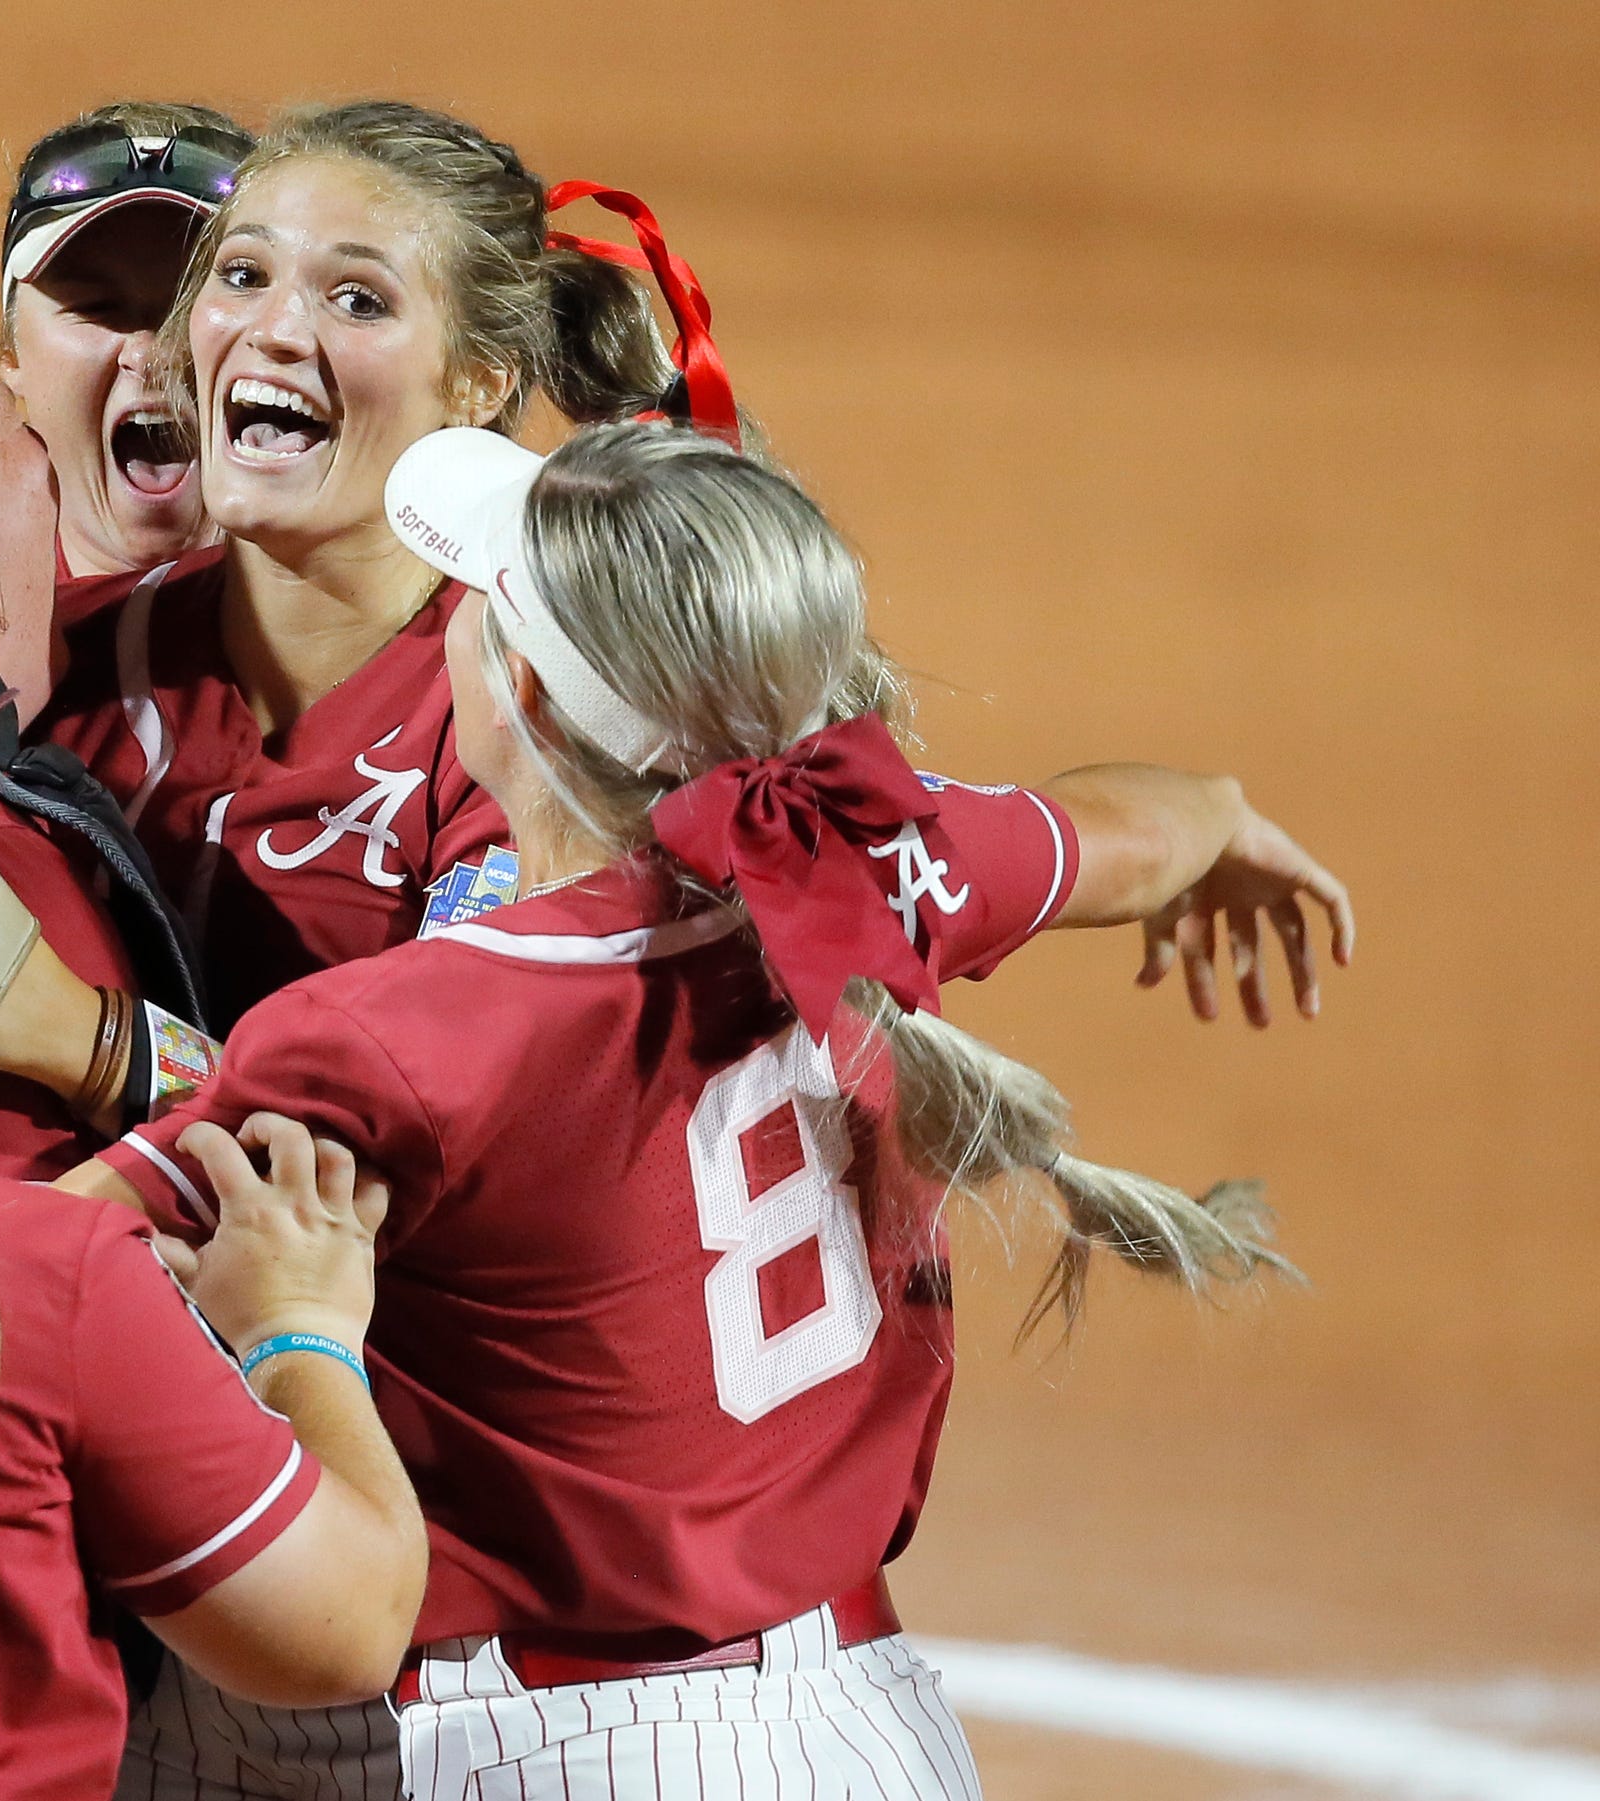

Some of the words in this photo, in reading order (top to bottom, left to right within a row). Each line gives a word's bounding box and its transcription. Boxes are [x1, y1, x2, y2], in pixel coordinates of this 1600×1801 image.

[396, 505, 463, 563] SOFTBALL
[257, 753, 427, 888] A
[458, 897, 480, 909] 2021
[487, 868, 515, 883] NCAA
[867, 818, 970, 946] A
[686, 1019, 884, 1425] 8
[291, 1335, 346, 1357] OVARIAN
